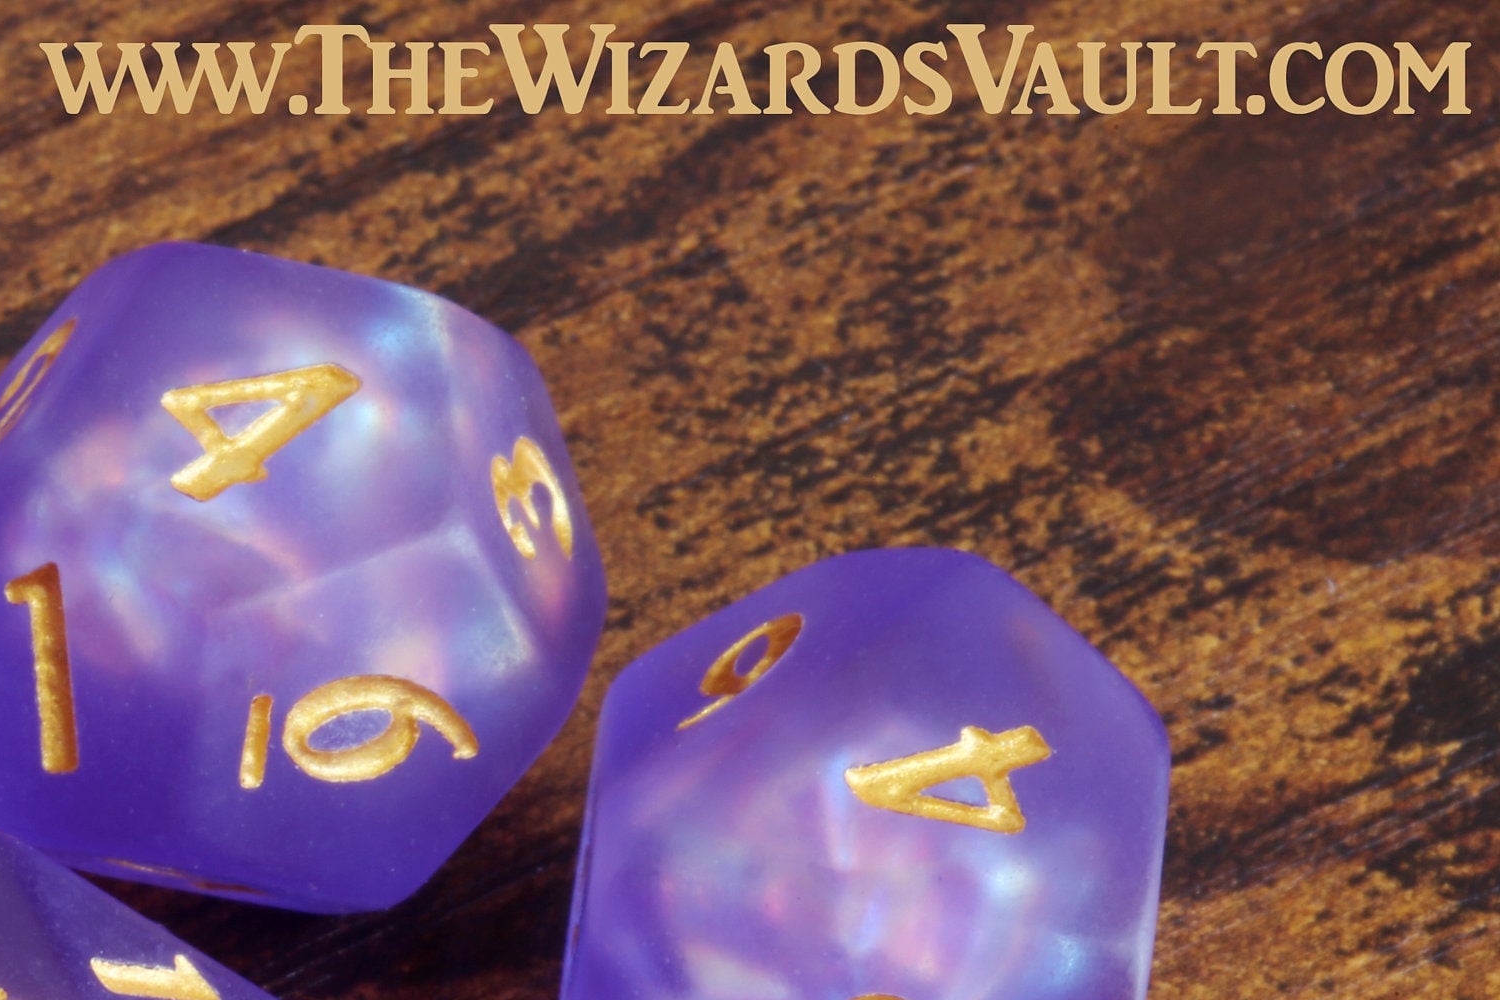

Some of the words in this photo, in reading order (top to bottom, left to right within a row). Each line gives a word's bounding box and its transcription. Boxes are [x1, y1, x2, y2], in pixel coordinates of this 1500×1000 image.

[161, 362, 362, 502] 4
[5, 562, 80, 775] 1
[844, 725, 1050, 834] 4
